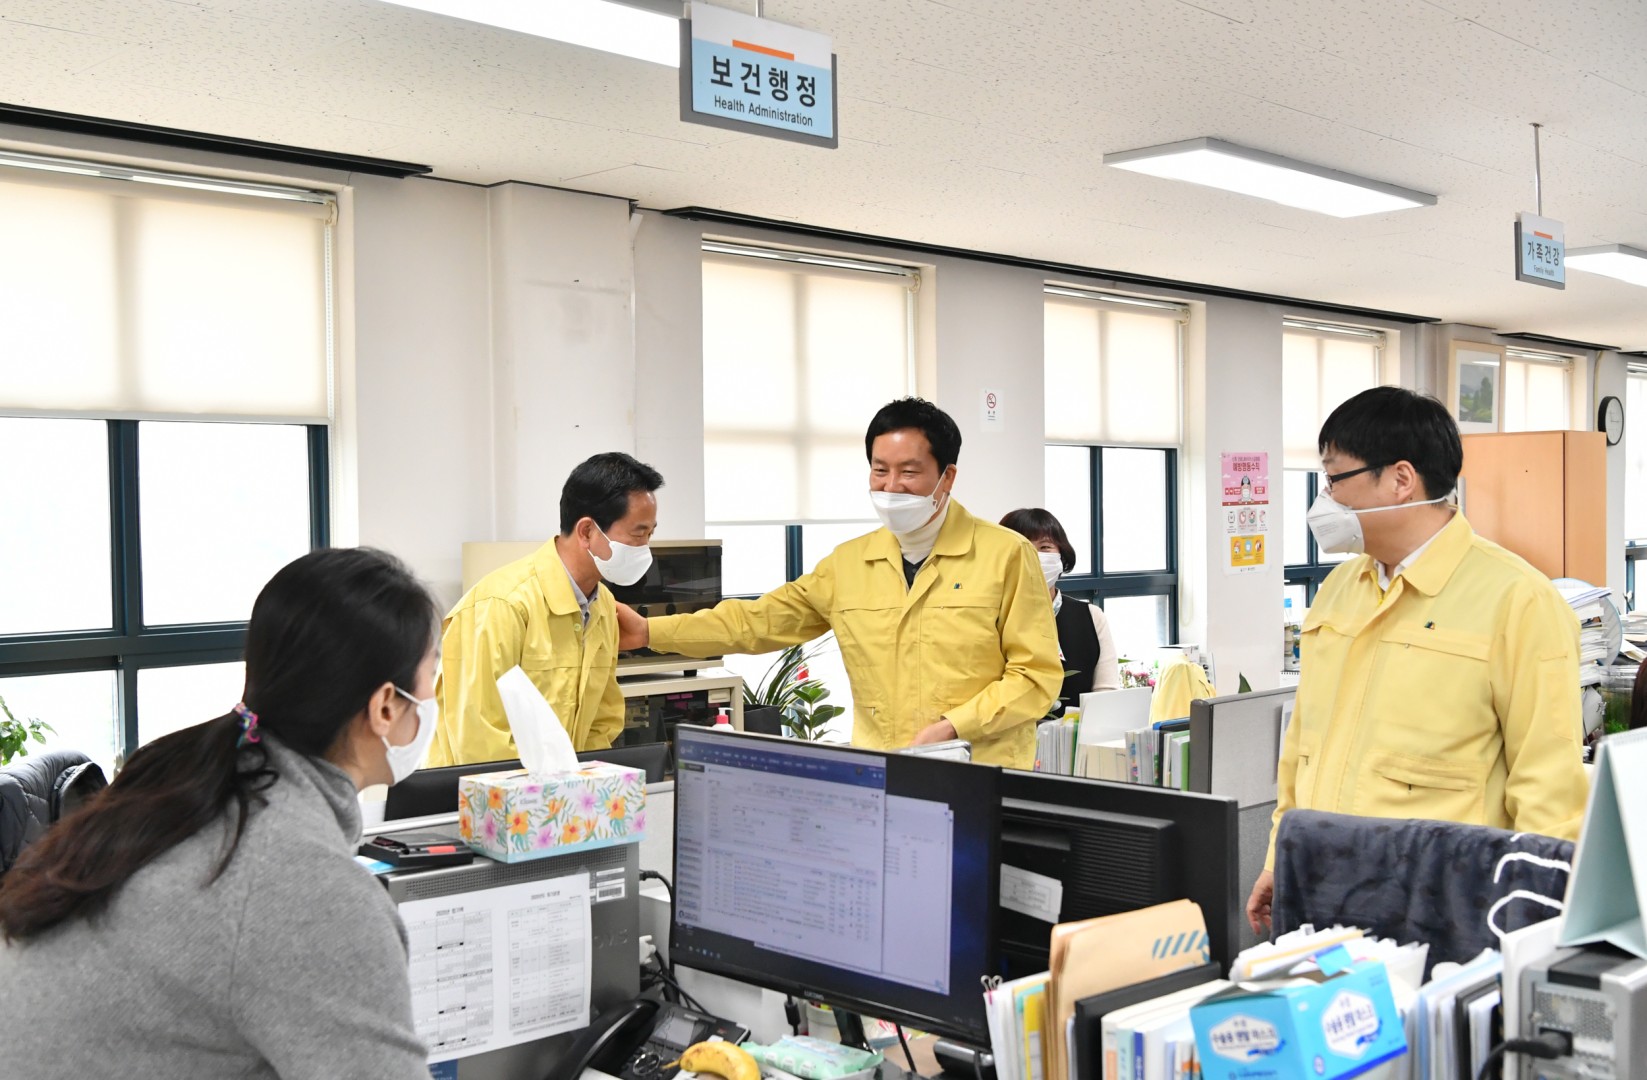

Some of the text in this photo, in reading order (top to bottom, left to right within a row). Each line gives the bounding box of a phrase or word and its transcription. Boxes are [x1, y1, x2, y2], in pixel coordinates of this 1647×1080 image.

[710, 55, 816, 108] 보건행정
[714, 95, 813, 127] Health Administration
[1527, 241, 1560, 266] 가족건강
